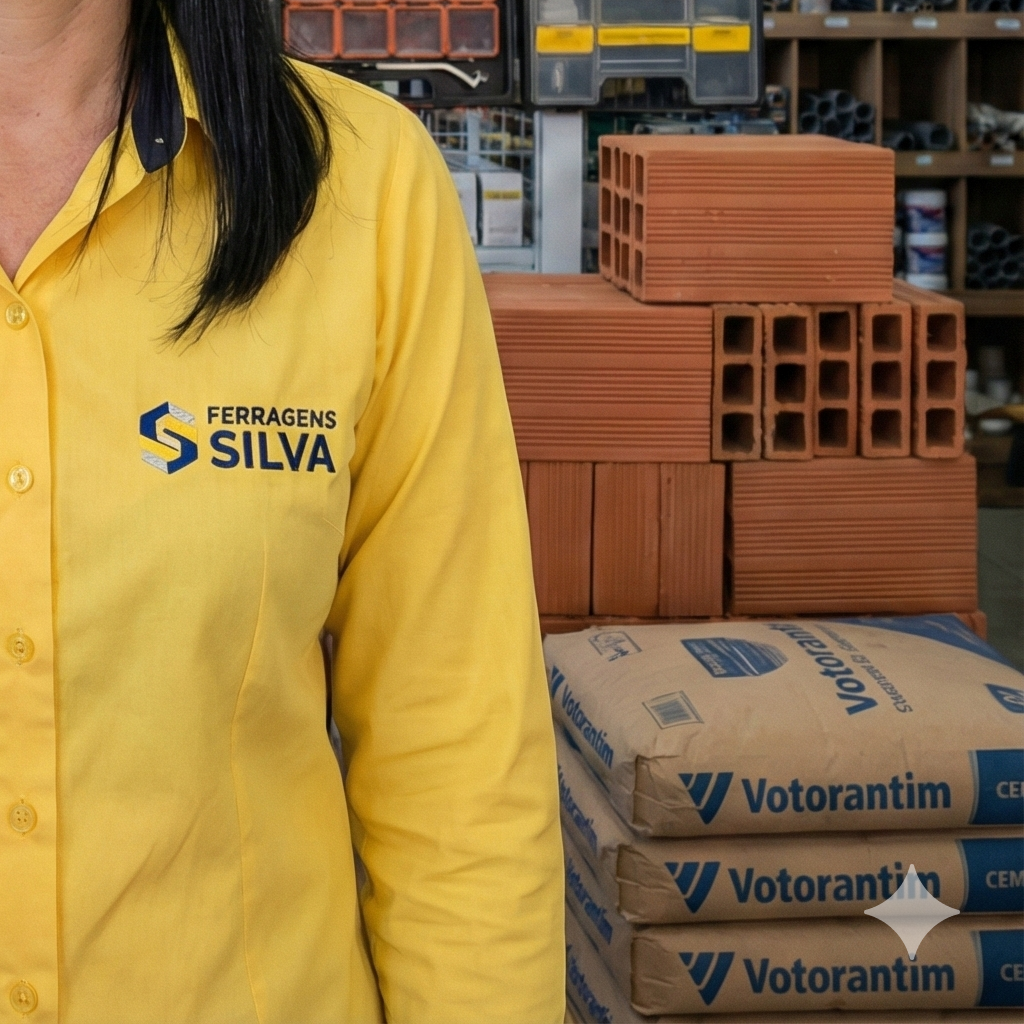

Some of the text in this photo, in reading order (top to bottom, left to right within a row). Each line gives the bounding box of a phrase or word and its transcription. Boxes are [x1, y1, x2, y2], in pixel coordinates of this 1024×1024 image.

[207, 405, 337, 429] FERRAGENS
[209, 429, 337, 473] SILVA
[561, 684, 615, 770] Votorantim
[741, 772, 952, 814] Votorantim
[728, 861, 942, 904] Votorantim
[742, 952, 956, 995] Votorantim
